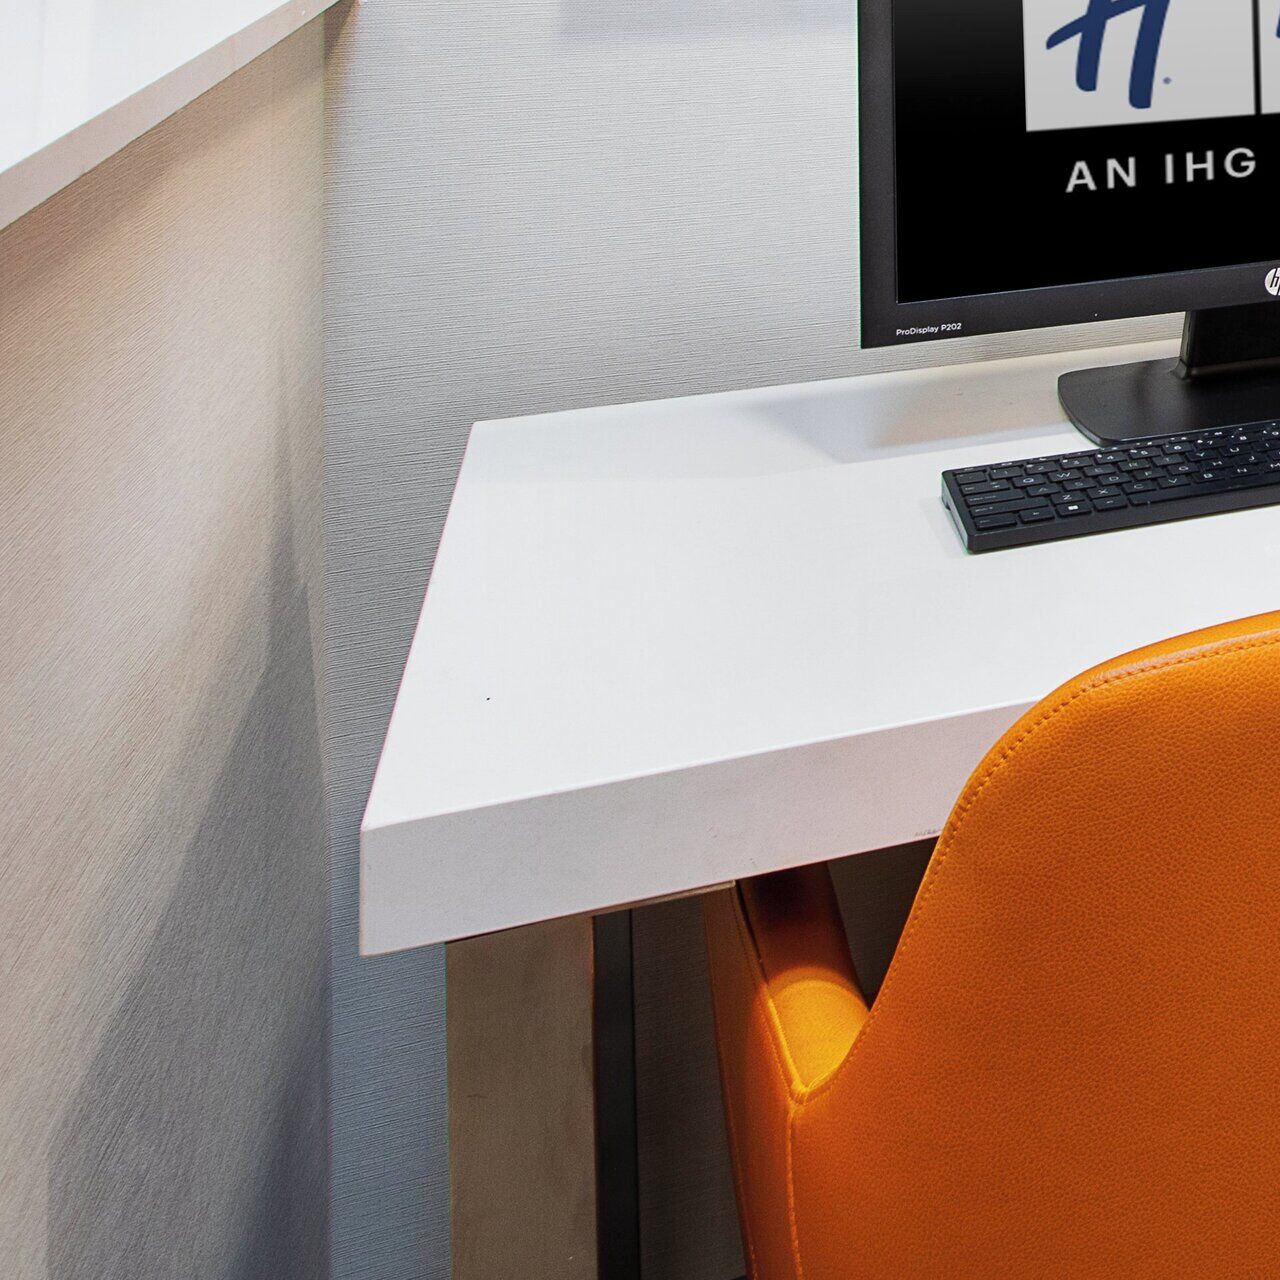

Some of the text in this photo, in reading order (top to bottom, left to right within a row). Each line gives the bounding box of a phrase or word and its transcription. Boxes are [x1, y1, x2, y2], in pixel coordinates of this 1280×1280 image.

[1065, 156, 1136, 193] AN
[1165, 147, 1256, 185] IHG
[896, 322, 962, 336] ProDisplay P202
